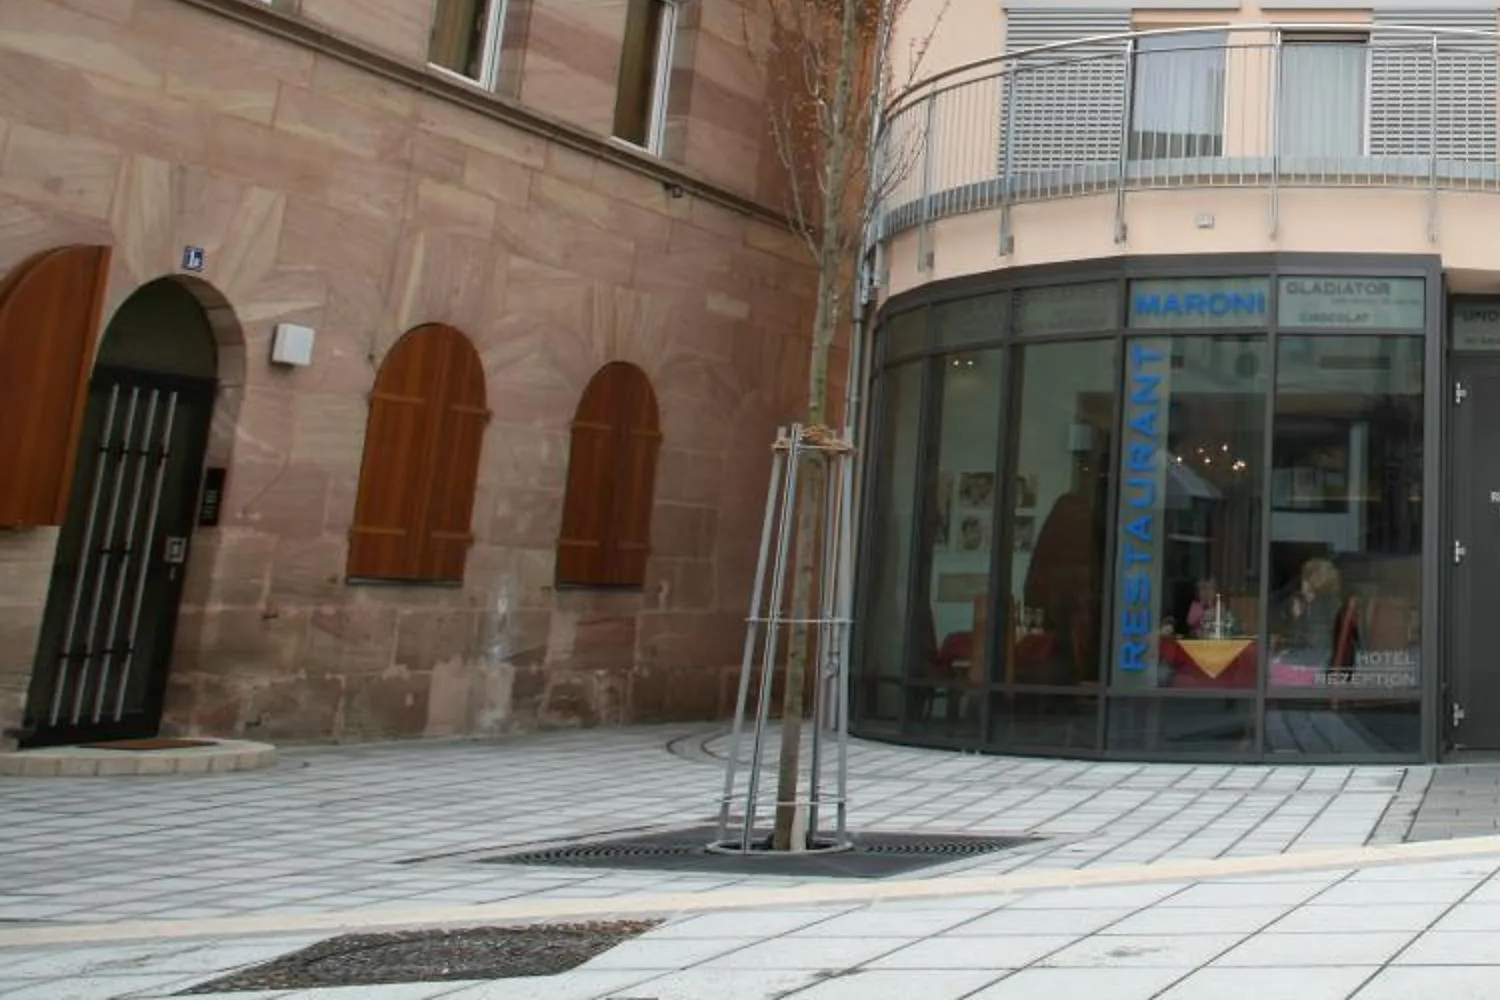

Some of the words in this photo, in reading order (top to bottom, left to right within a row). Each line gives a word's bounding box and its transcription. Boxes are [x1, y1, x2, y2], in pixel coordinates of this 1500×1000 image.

[1285, 281, 1391, 297] GLADIATOR
[1134, 287, 1267, 317] MARONI
[1118, 343, 1166, 673] RESTAURANT
[1356, 651, 1415, 666] HOTEL
